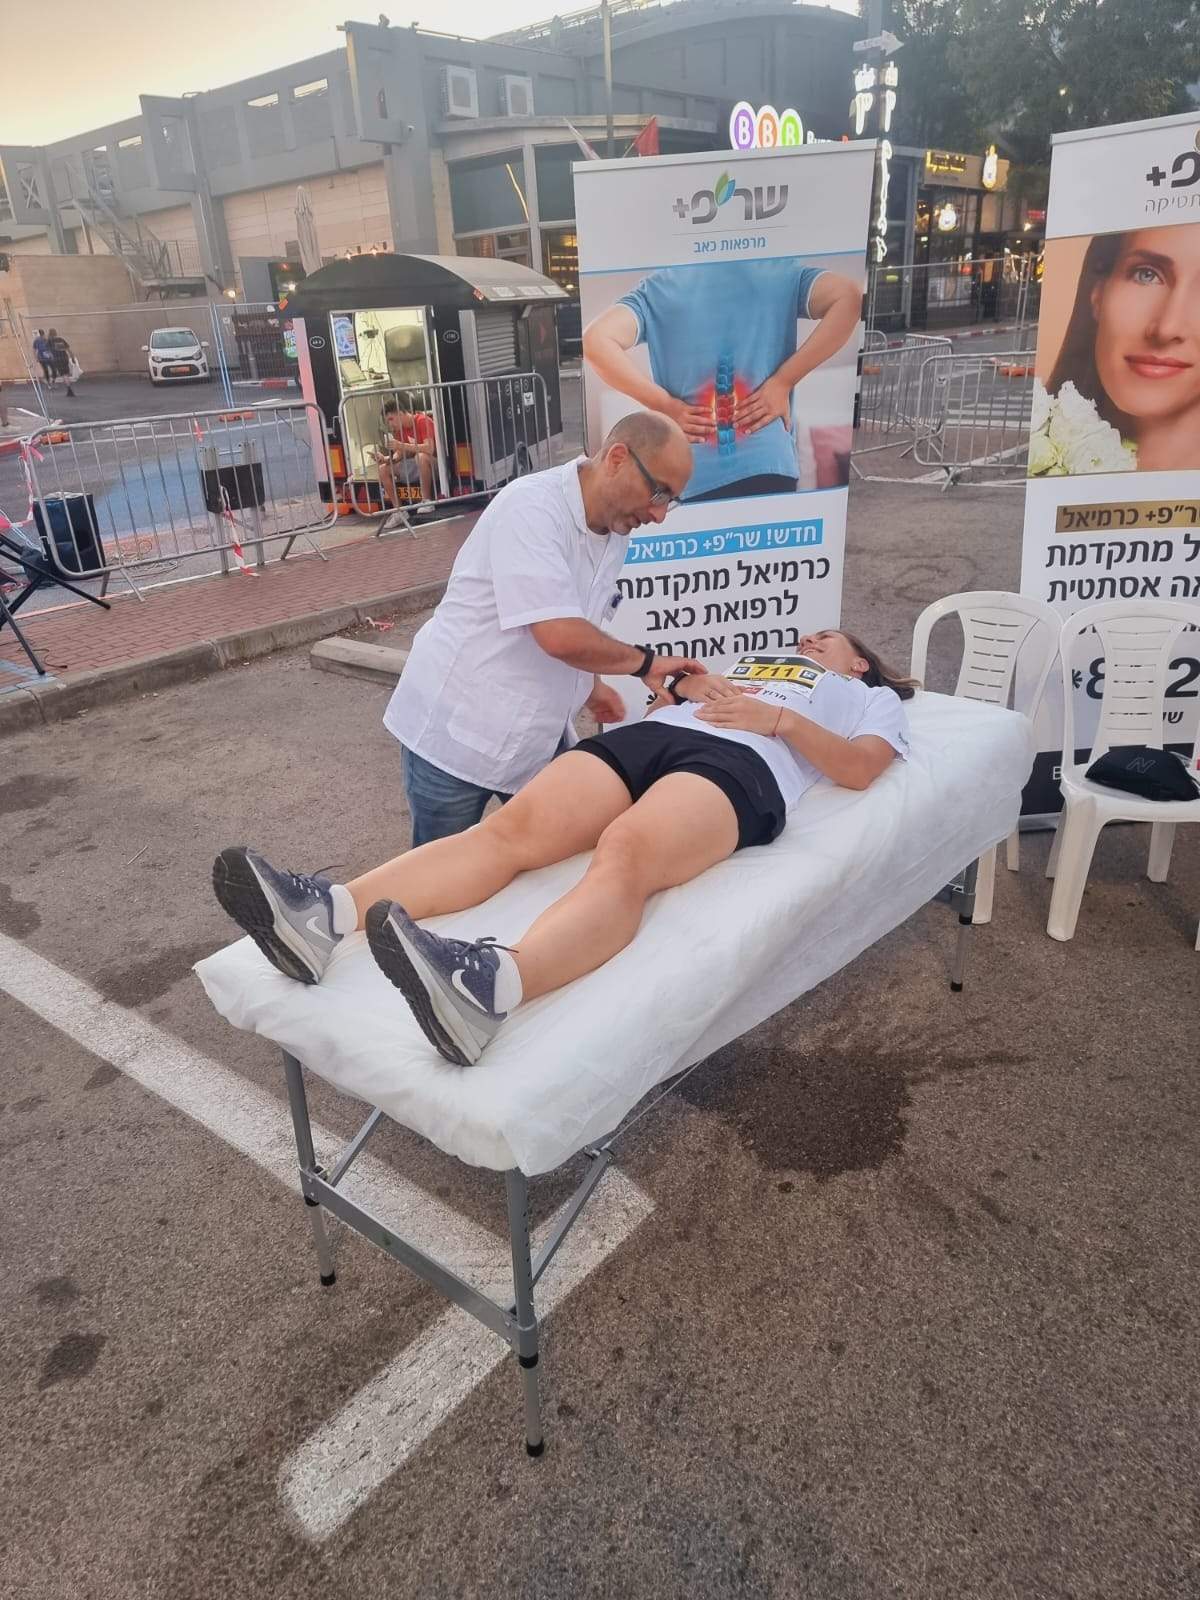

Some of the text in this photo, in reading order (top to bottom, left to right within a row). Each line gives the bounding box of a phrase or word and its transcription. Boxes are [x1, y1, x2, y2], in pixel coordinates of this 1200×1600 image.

[694, 235, 766, 254] מרפאות כאב
[1062, 507, 1139, 529] כרמיאל
[766, 524, 817, 546] חדש!
[628, 537, 698, 560] כרמיאל
[1045, 539, 1174, 571] מתקדמת
[616, 557, 831, 601] כרמיאל מתקדמת
[1047, 576, 1162, 603] אסתטית
[646, 589, 799, 632] לרפואת כאב
[734, 626, 800, 654] ברמה
[754, 666, 794, 677] 711
